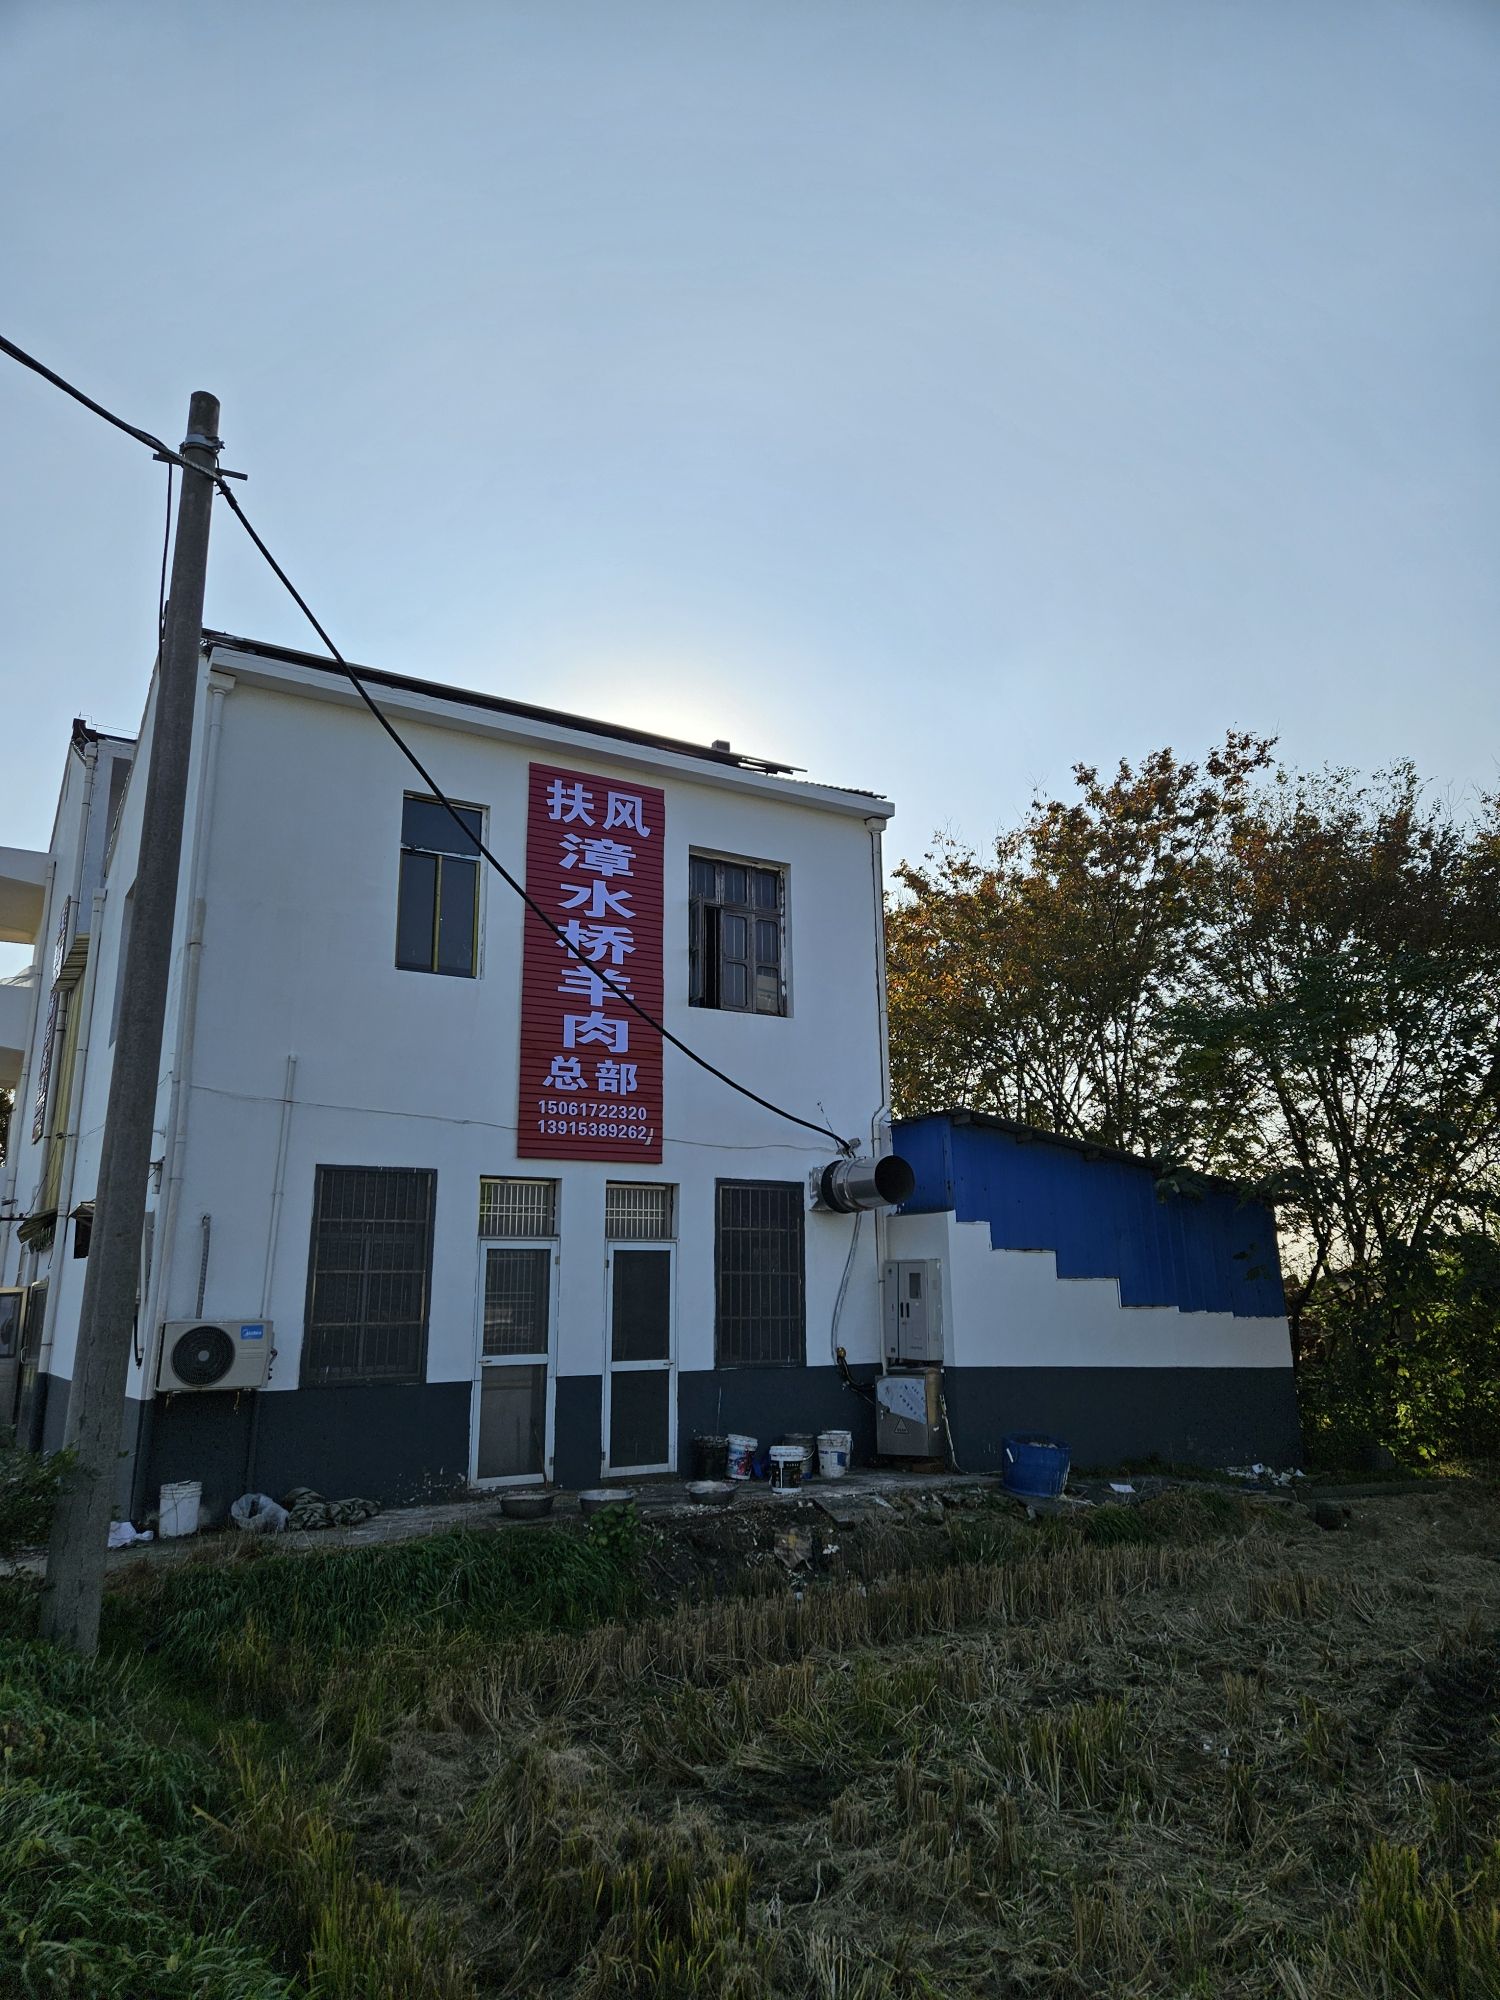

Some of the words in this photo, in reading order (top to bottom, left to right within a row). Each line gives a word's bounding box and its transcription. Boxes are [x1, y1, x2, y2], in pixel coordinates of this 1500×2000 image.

[546, 779, 652, 838] 扶风
[557, 832, 638, 1053] 漳水桥羊肉
[542, 1055, 639, 1096] 总部
[537, 1099, 648, 1121] 15061722320
[537, 1118, 648, 1141] 13915389262
